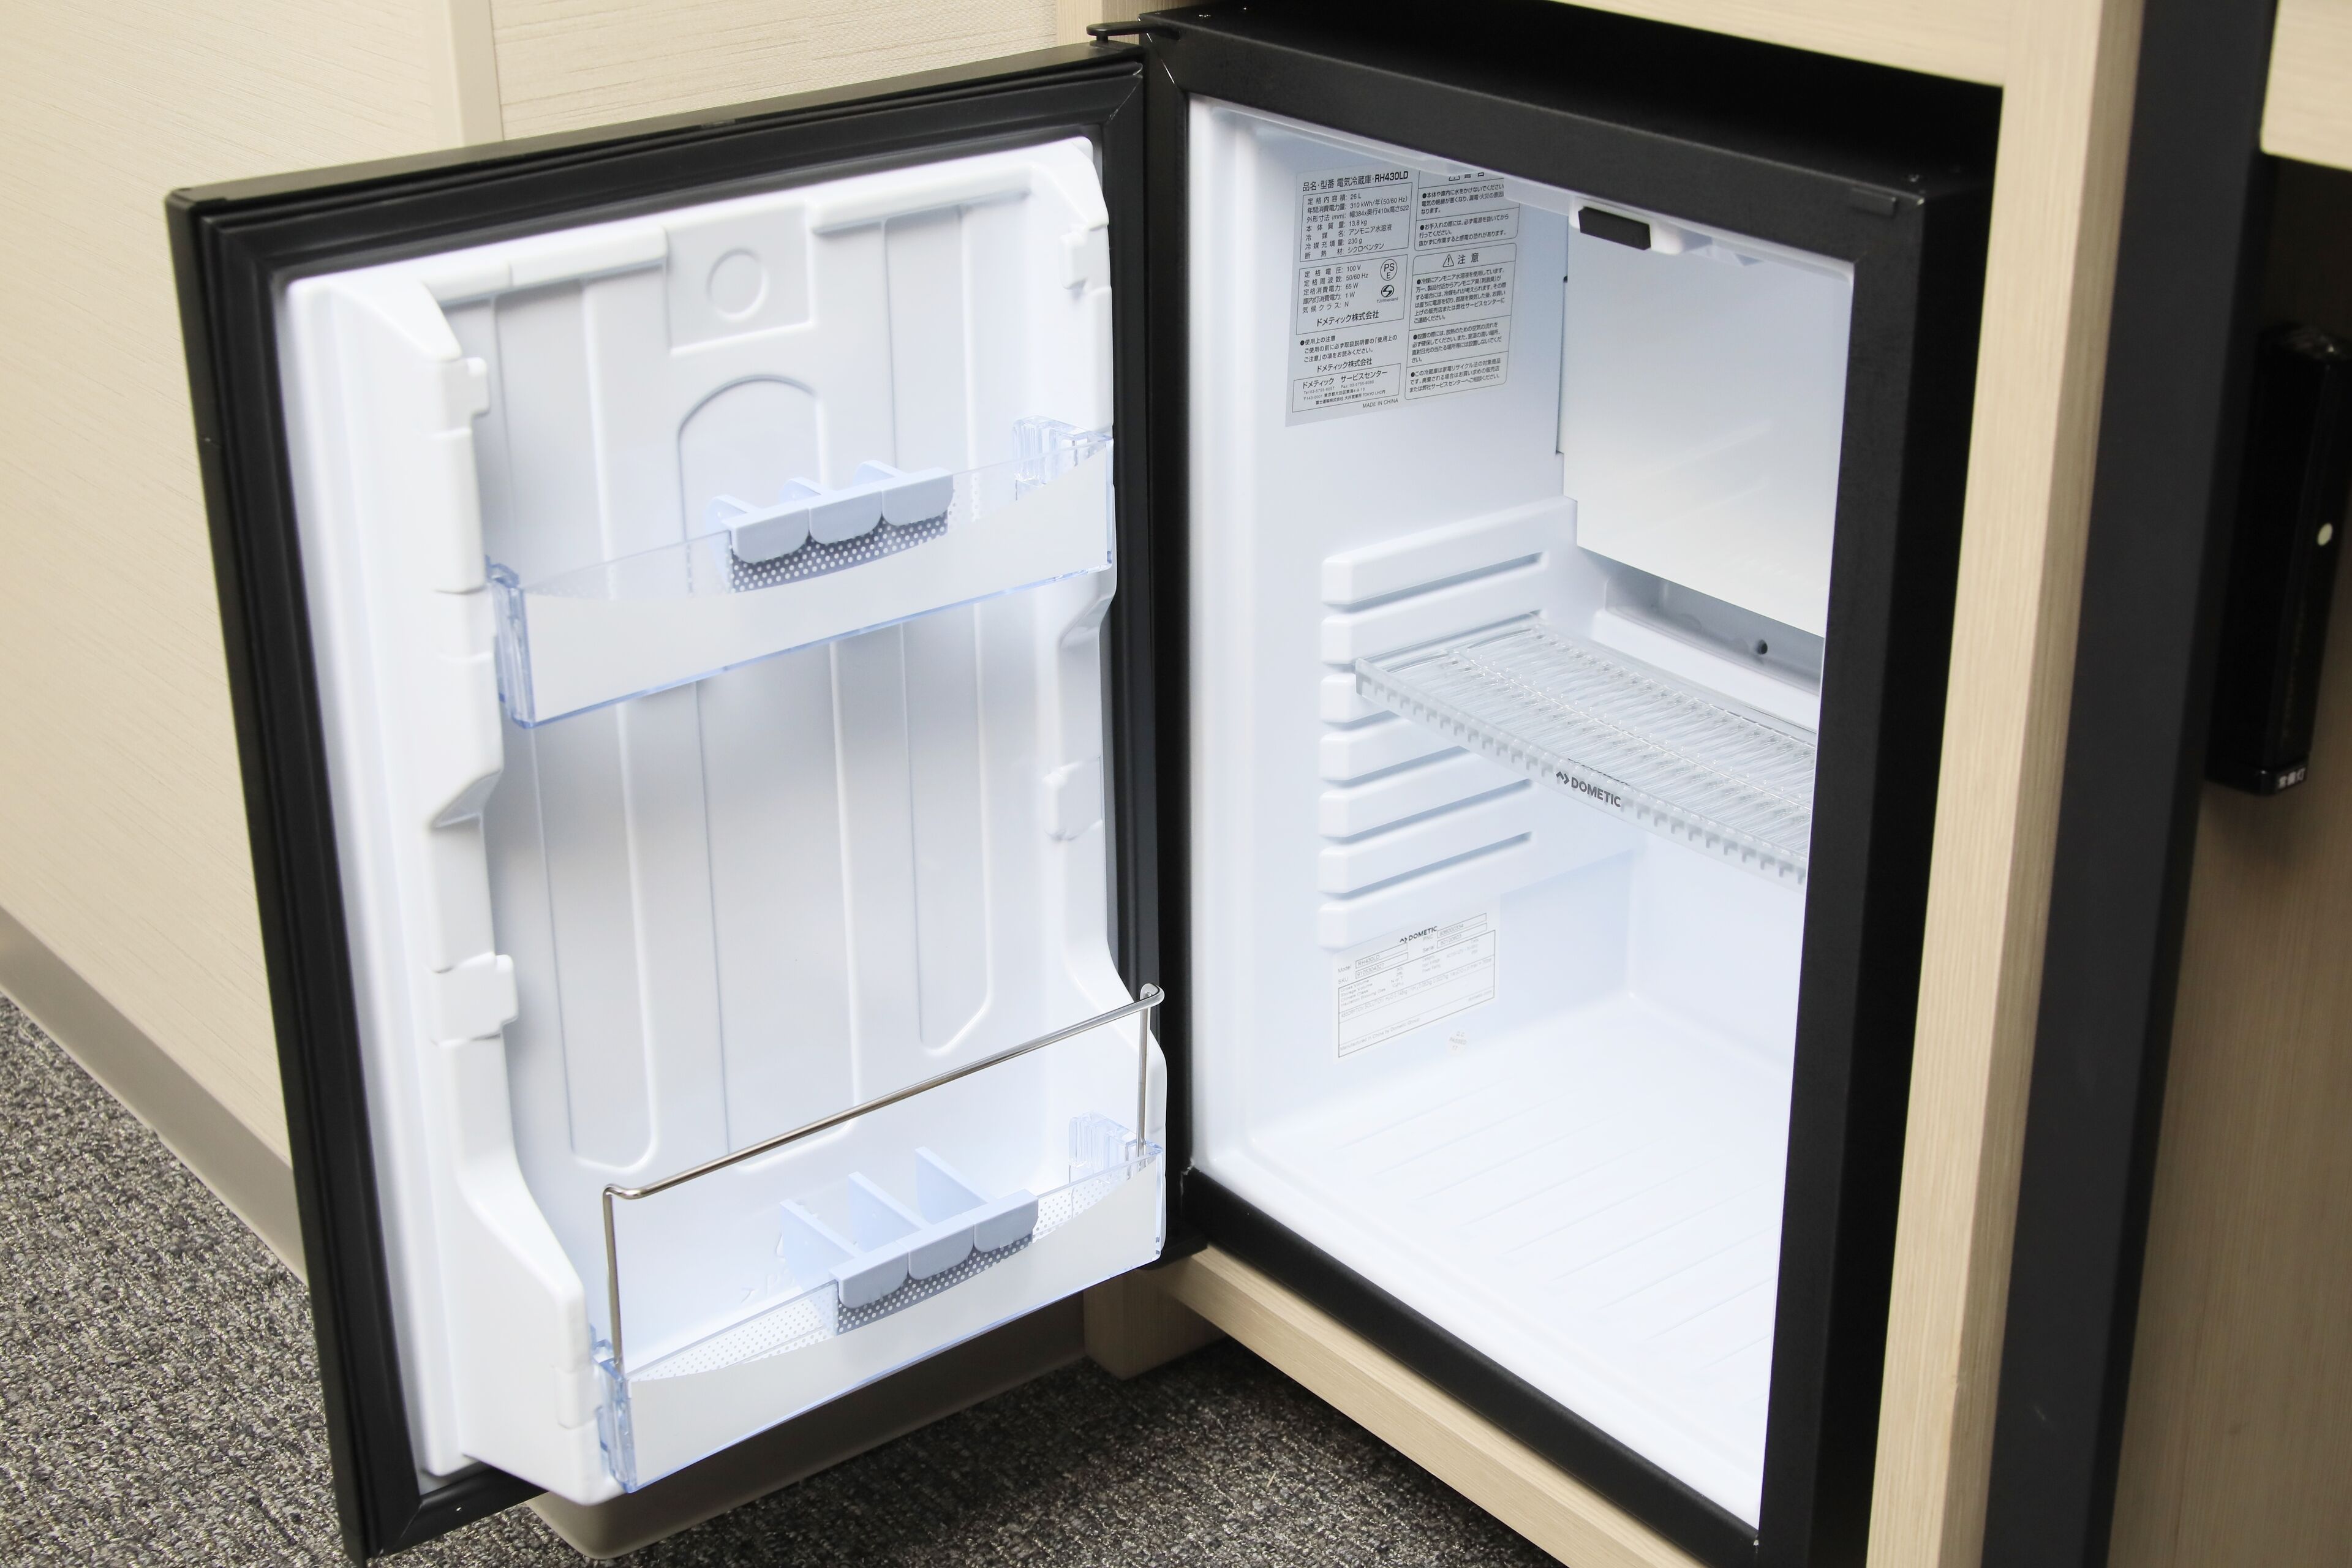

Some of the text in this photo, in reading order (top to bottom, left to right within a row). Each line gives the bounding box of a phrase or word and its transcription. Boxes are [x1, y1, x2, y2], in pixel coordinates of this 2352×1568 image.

[1349, 224, 1392, 235] アンモニア水溶液
[1348, 243, 1384, 254] シクロペンタン
[1384, 263, 1395, 272] PS
[1317, 310, 1379, 326] ドメティック株式会社
[1317, 358, 1372, 372] ドメティック株式会社
[1303, 371, 1388, 389] ドメティック サービスセンター
[1571, 777, 1621, 807] DOMETIC
[1408, 925, 1438, 941] DOMETIC
